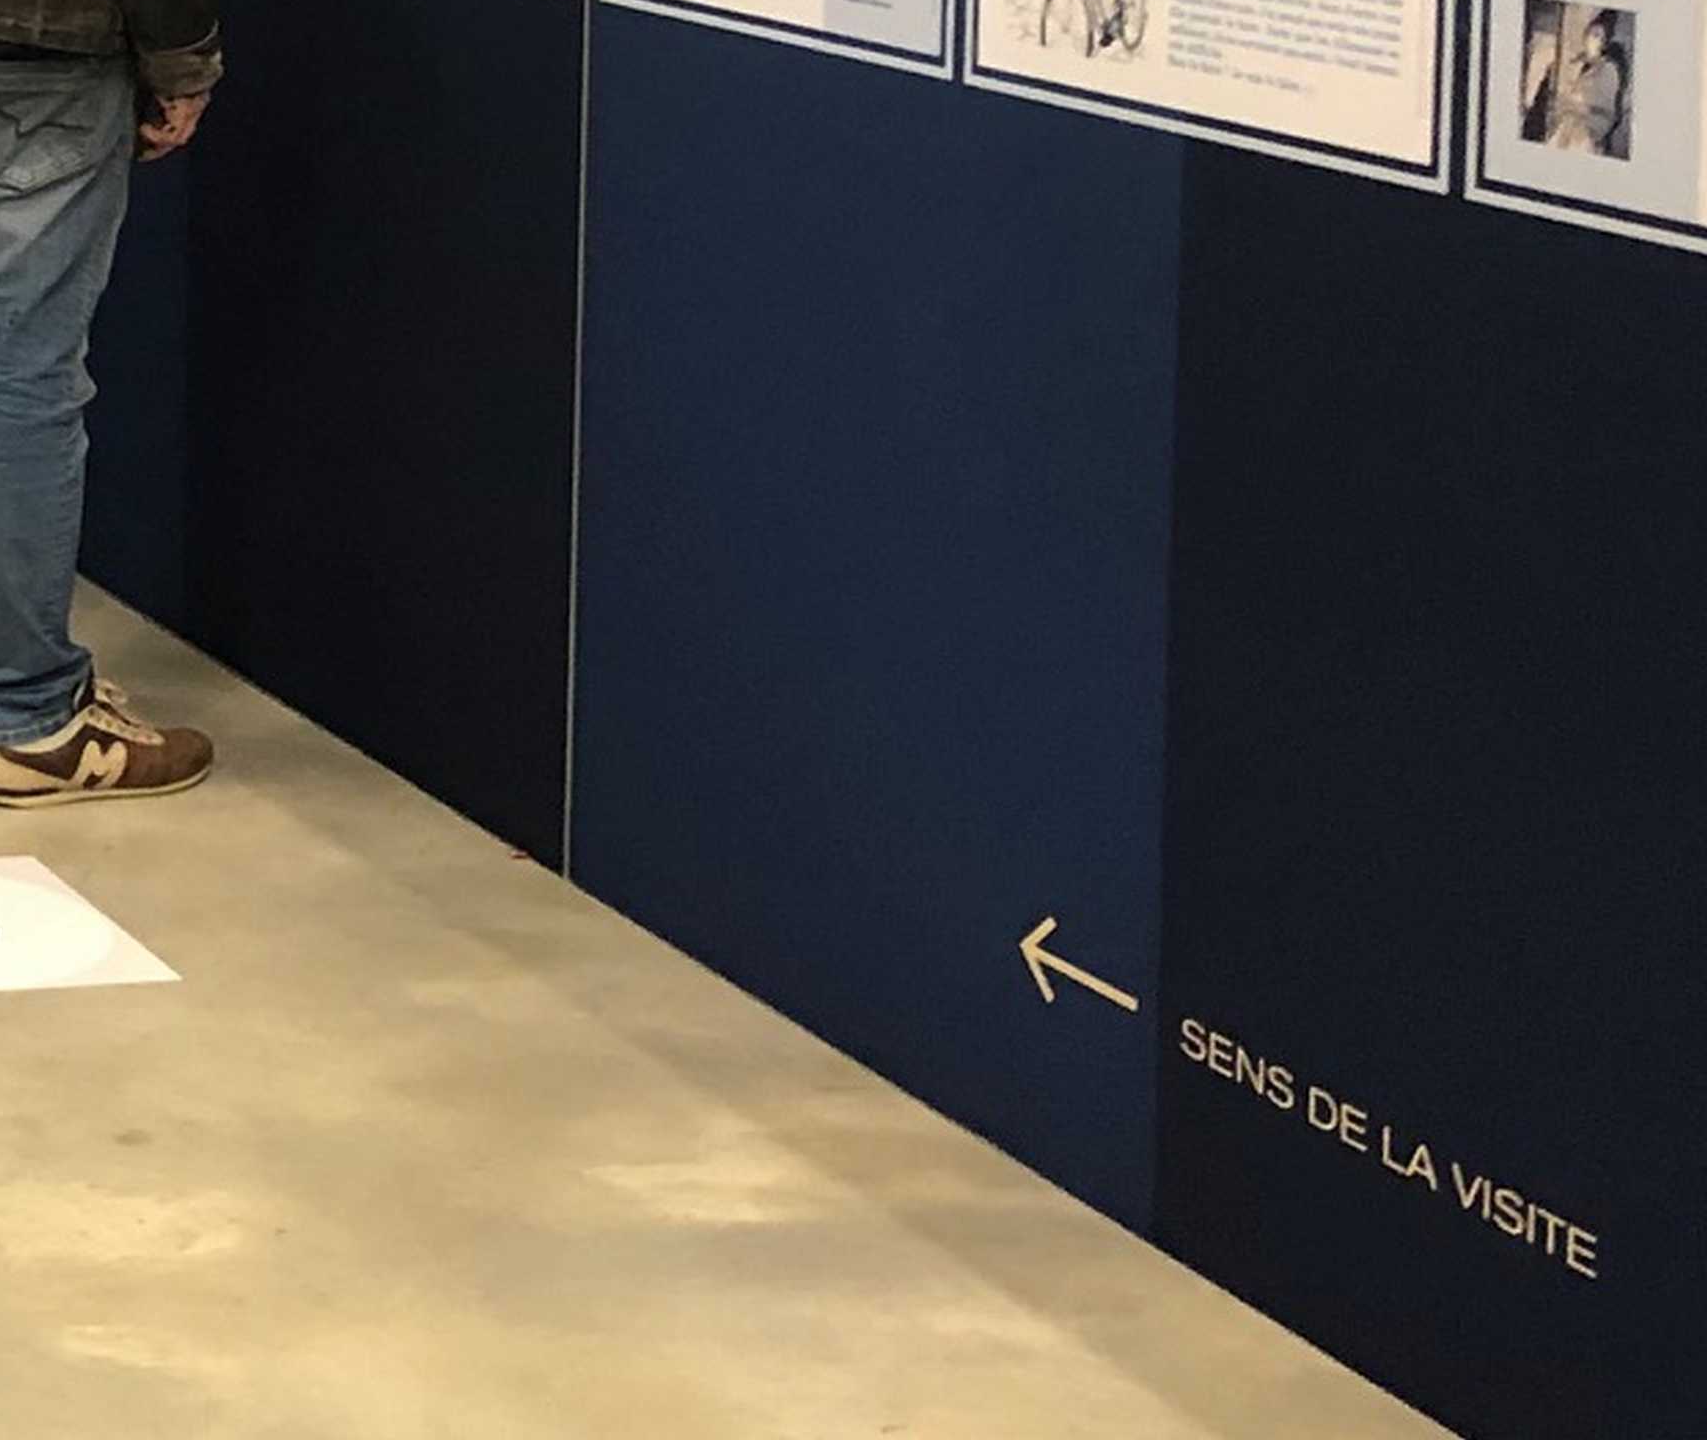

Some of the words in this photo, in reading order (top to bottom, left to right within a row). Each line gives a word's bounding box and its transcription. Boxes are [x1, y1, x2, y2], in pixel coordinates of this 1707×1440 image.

[1180, 1017, 1295, 1110] SENS
[1307, 1085, 1368, 1151] DE
[1380, 1125, 1439, 1192] LA
[1450, 1162, 1598, 1279] VISITE
